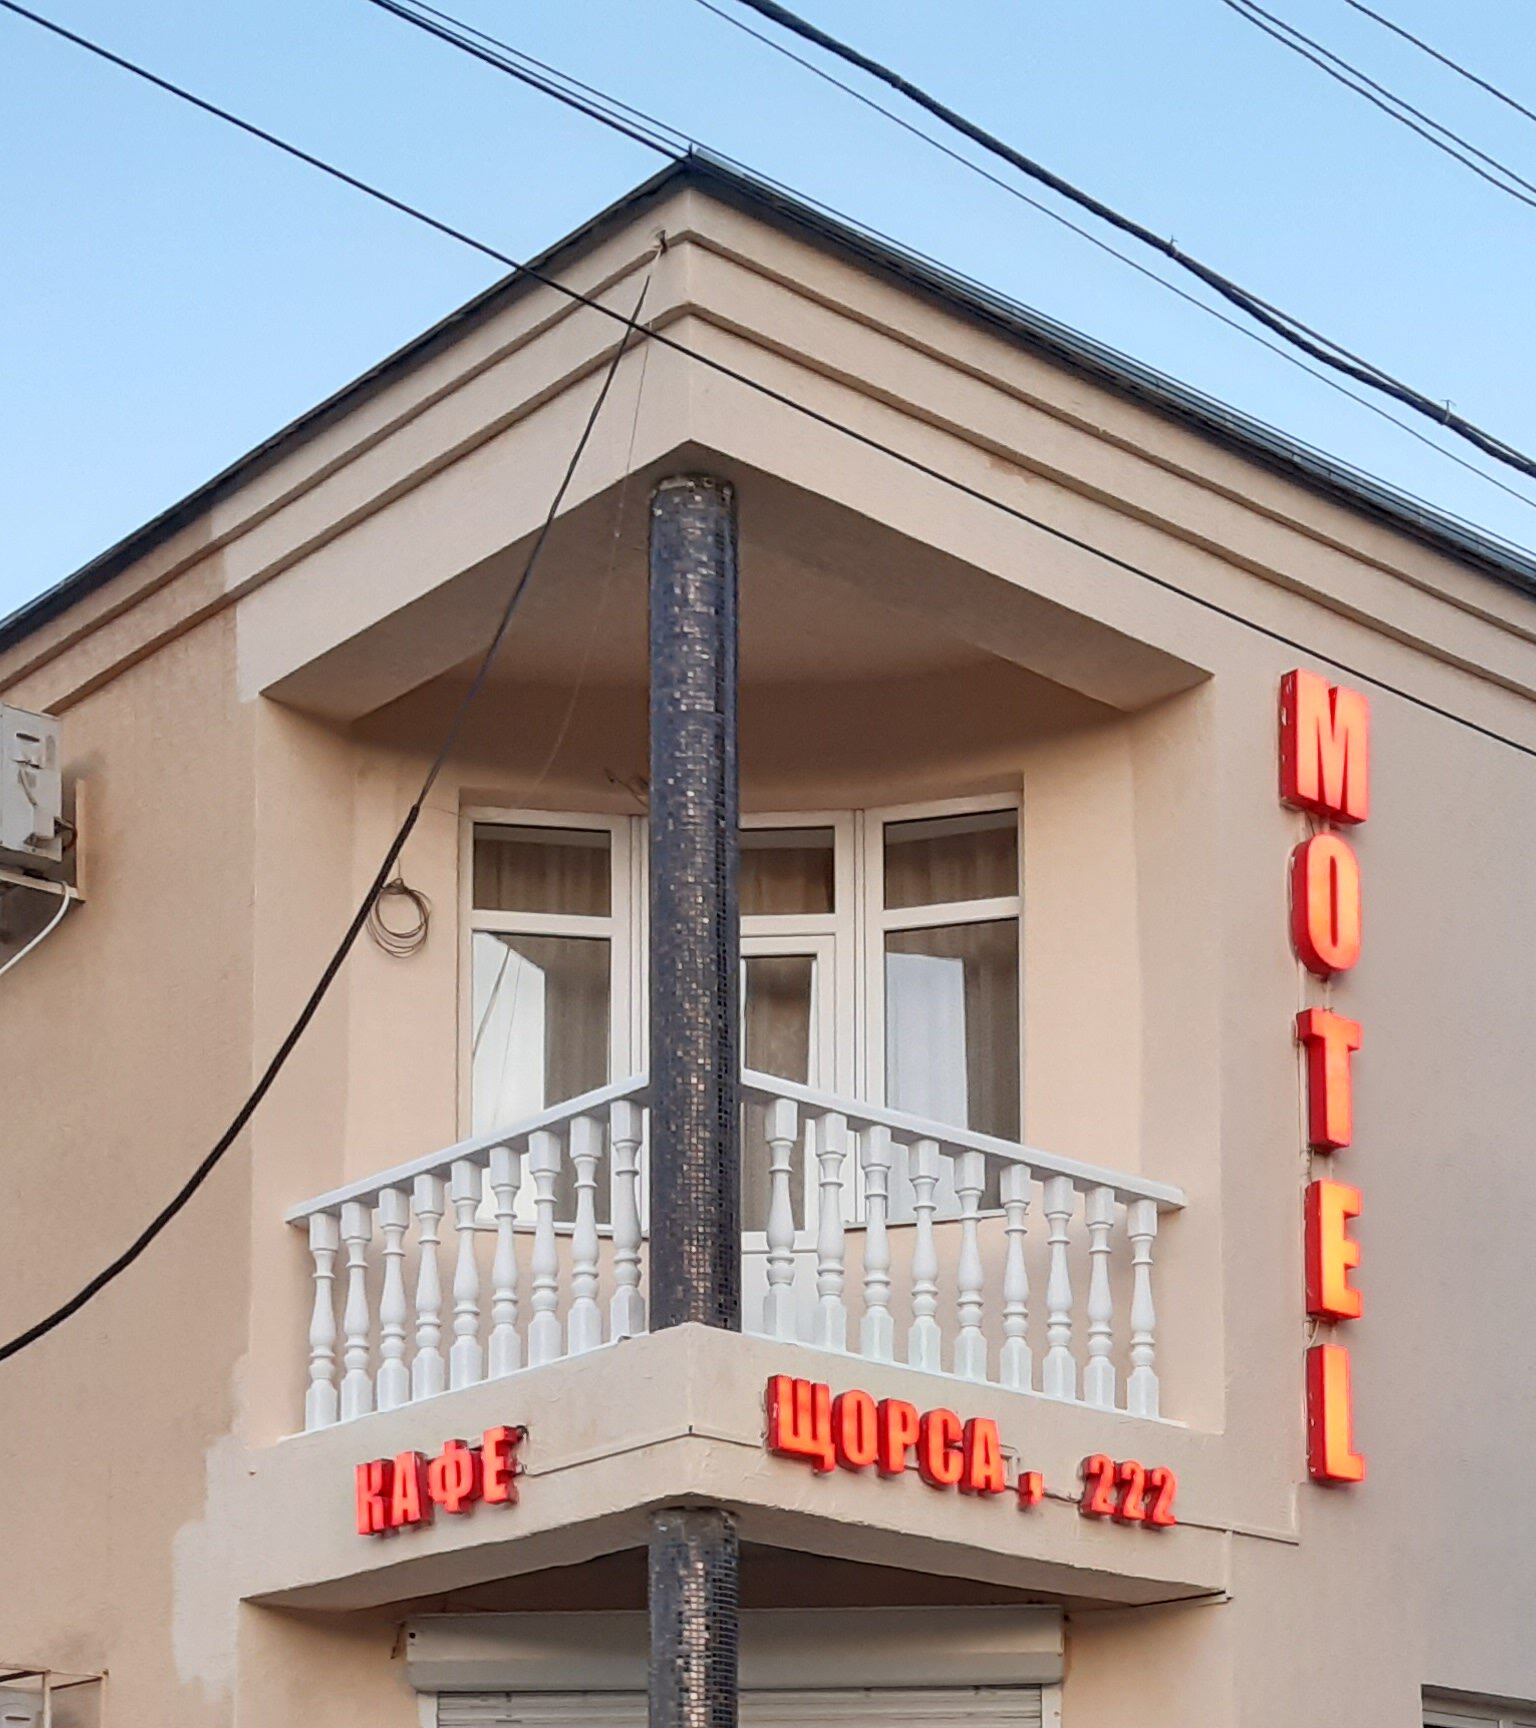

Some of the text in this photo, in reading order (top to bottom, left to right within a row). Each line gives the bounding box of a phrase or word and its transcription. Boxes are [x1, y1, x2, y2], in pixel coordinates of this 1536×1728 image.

[1279, 668, 1368, 1482] MOTEL
[355, 1426, 520, 1536] КАФЕ
[1080, 1453, 1178, 1527] 222
